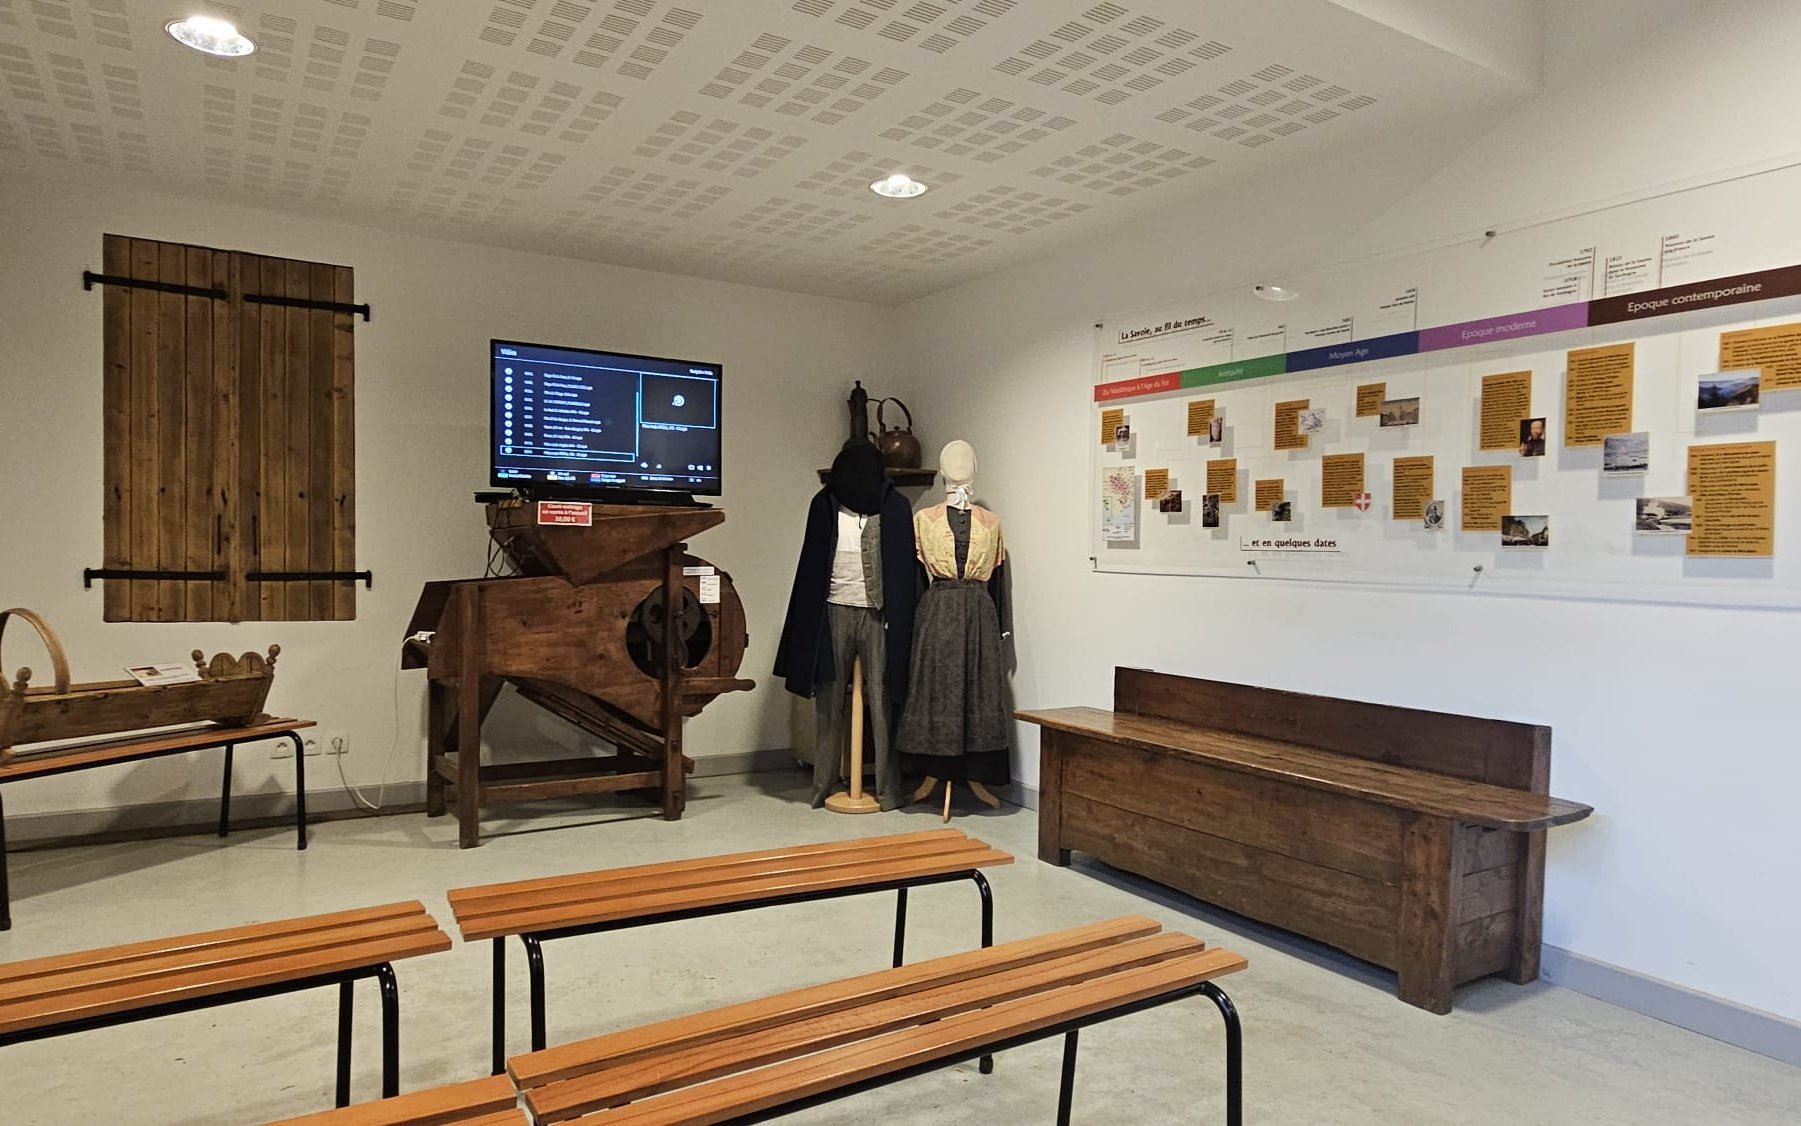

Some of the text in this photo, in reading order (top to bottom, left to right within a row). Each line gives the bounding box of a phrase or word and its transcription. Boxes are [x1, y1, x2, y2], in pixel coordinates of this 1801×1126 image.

[1627, 282, 1762, 313] Epoque contemporaine
[1121, 331, 1129, 340] La
[1130, 327, 1152, 338] Savoie,
[1164, 321, 1172, 331] fil
[1173, 320, 1182, 329] du
[1461, 320, 1538, 340] Epoque moderne
[1328, 351, 1354, 360] Moyen
[1252, 539, 1260, 547] et
[1274, 538, 1311, 548] quelques
[1313, 538, 1337, 548] dates
